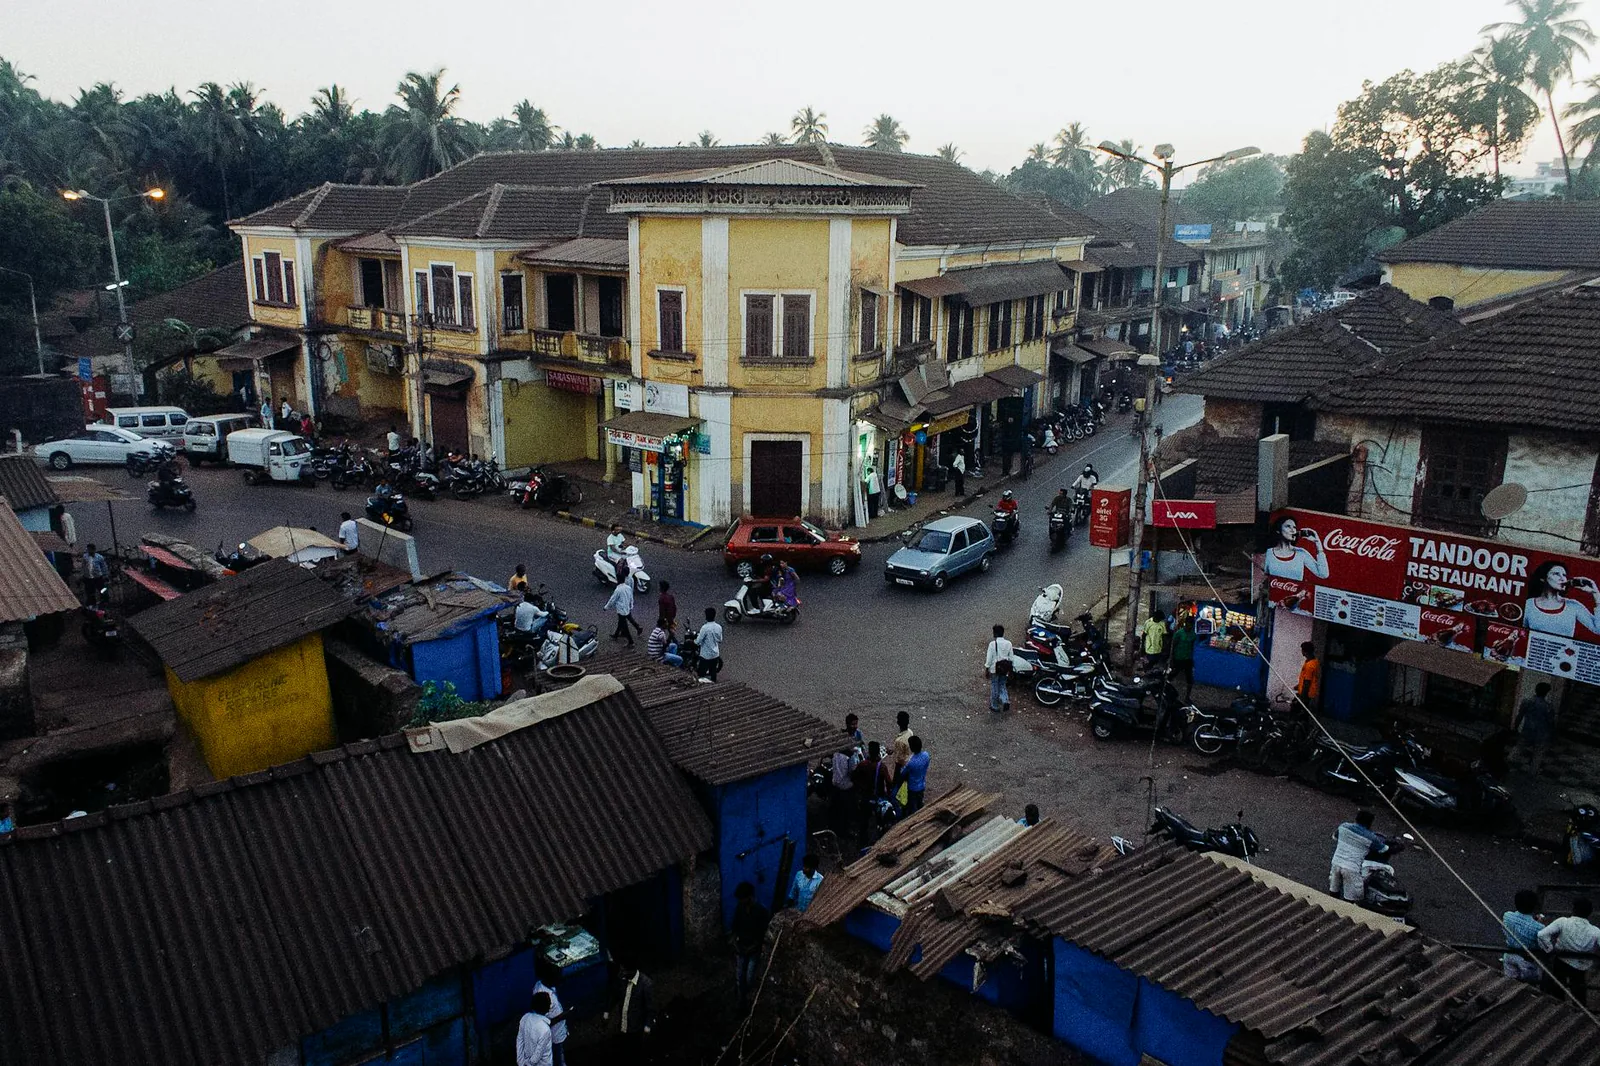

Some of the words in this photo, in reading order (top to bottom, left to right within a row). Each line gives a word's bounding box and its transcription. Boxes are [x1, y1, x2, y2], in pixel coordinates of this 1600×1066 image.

[1096, 508, 1112, 516] airtel
[1166, 510, 1198, 520] LAVA
[1324, 528, 1401, 562] Coca-Cola
[1409, 536, 1529, 578] TANDOOR
[1407, 562, 1525, 598] RESTAURANT
